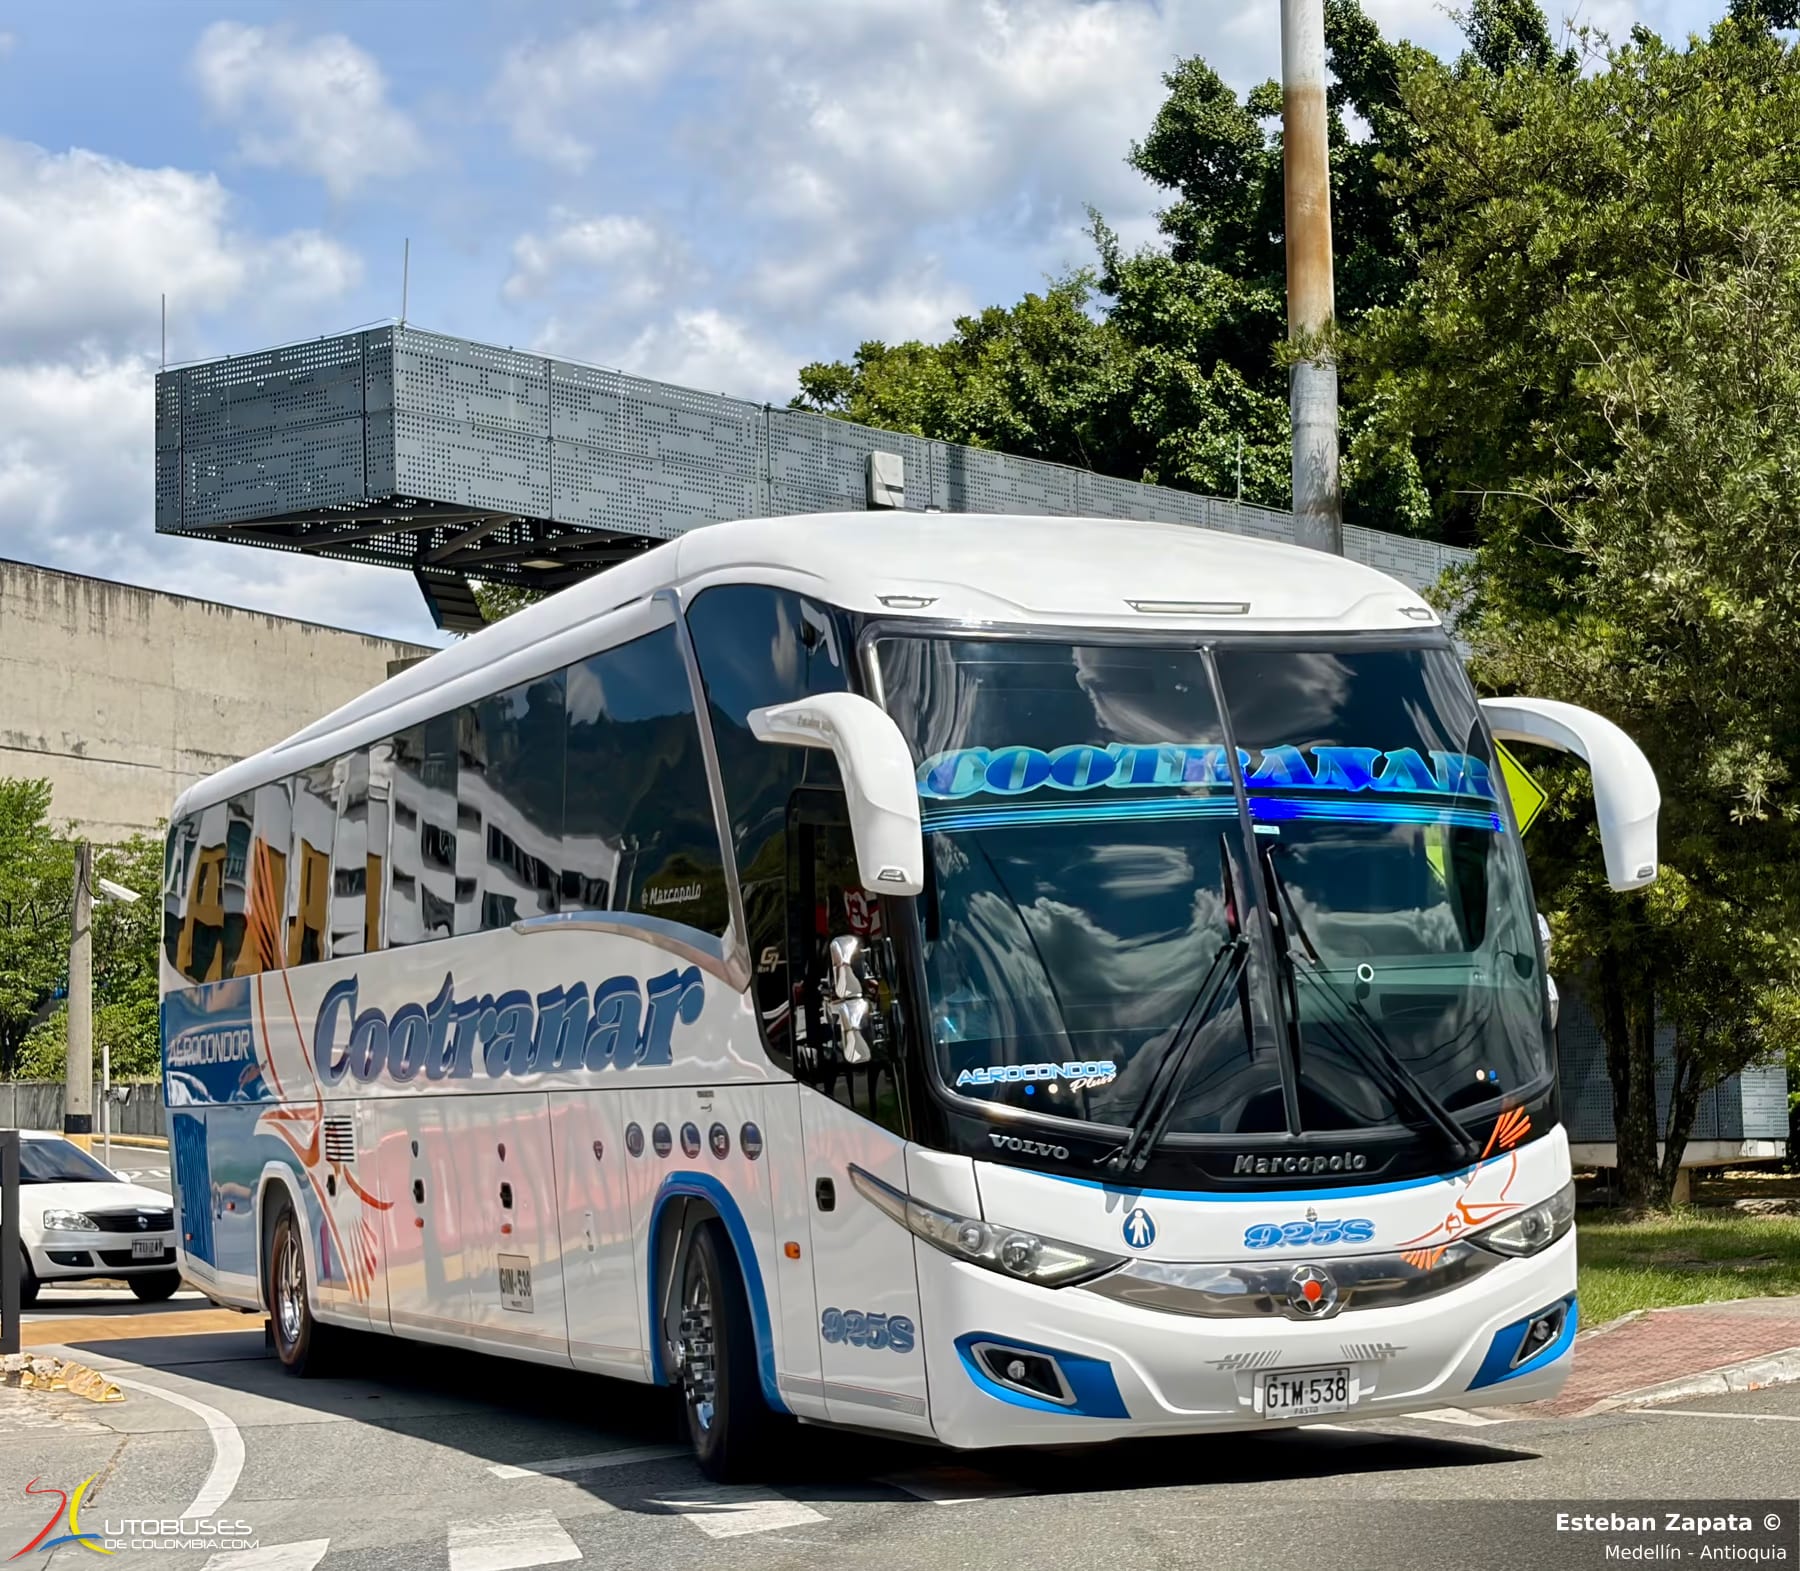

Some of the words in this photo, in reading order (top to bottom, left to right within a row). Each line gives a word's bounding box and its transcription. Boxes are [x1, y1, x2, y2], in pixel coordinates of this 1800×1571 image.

[917, 742, 1491, 799] COOTRANAR
[650, 881, 702, 905] Marcopolo
[314, 965, 705, 1087] Cootranar
[166, 1028, 250, 1068] AEROCONDOR
[956, 1060, 1117, 1087] AEROCONDOR
[988, 1133, 1070, 1160] VOLVO
[1232, 1151, 1367, 1175] Marcopolo
[1310, 1377, 1346, 1403] 538
